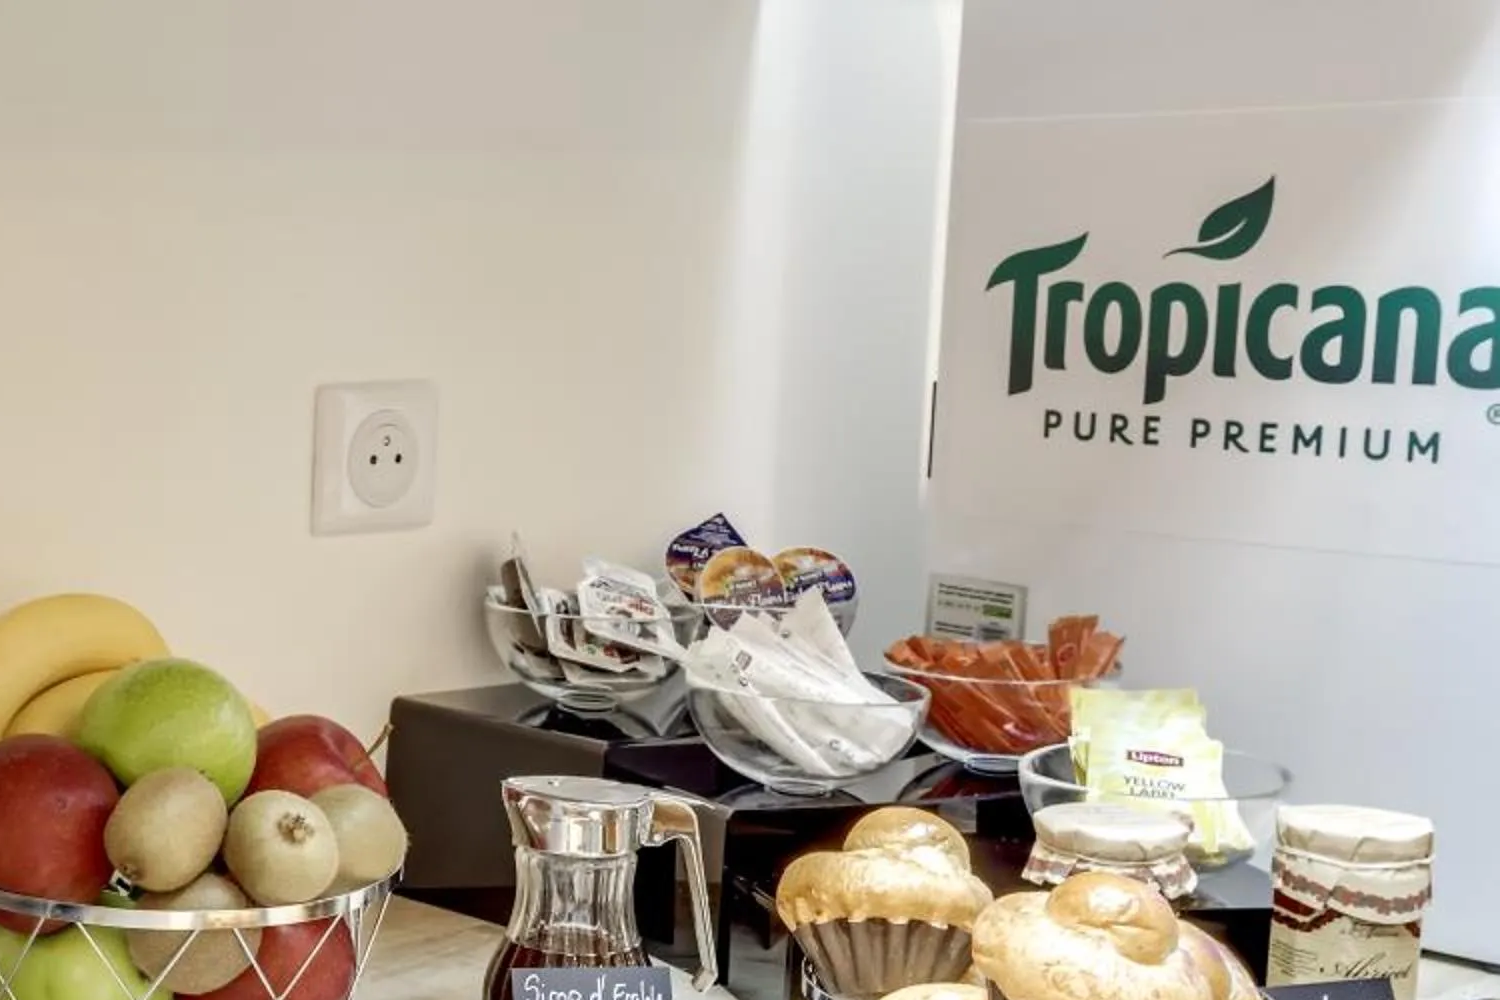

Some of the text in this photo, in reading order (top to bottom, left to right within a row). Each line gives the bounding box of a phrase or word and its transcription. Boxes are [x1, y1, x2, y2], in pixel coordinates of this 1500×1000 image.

[984, 231, 1500, 405] Tropicana
[1043, 410, 1441, 464] PURE PREMIUM
[1123, 775, 1186, 792] YELLOW
